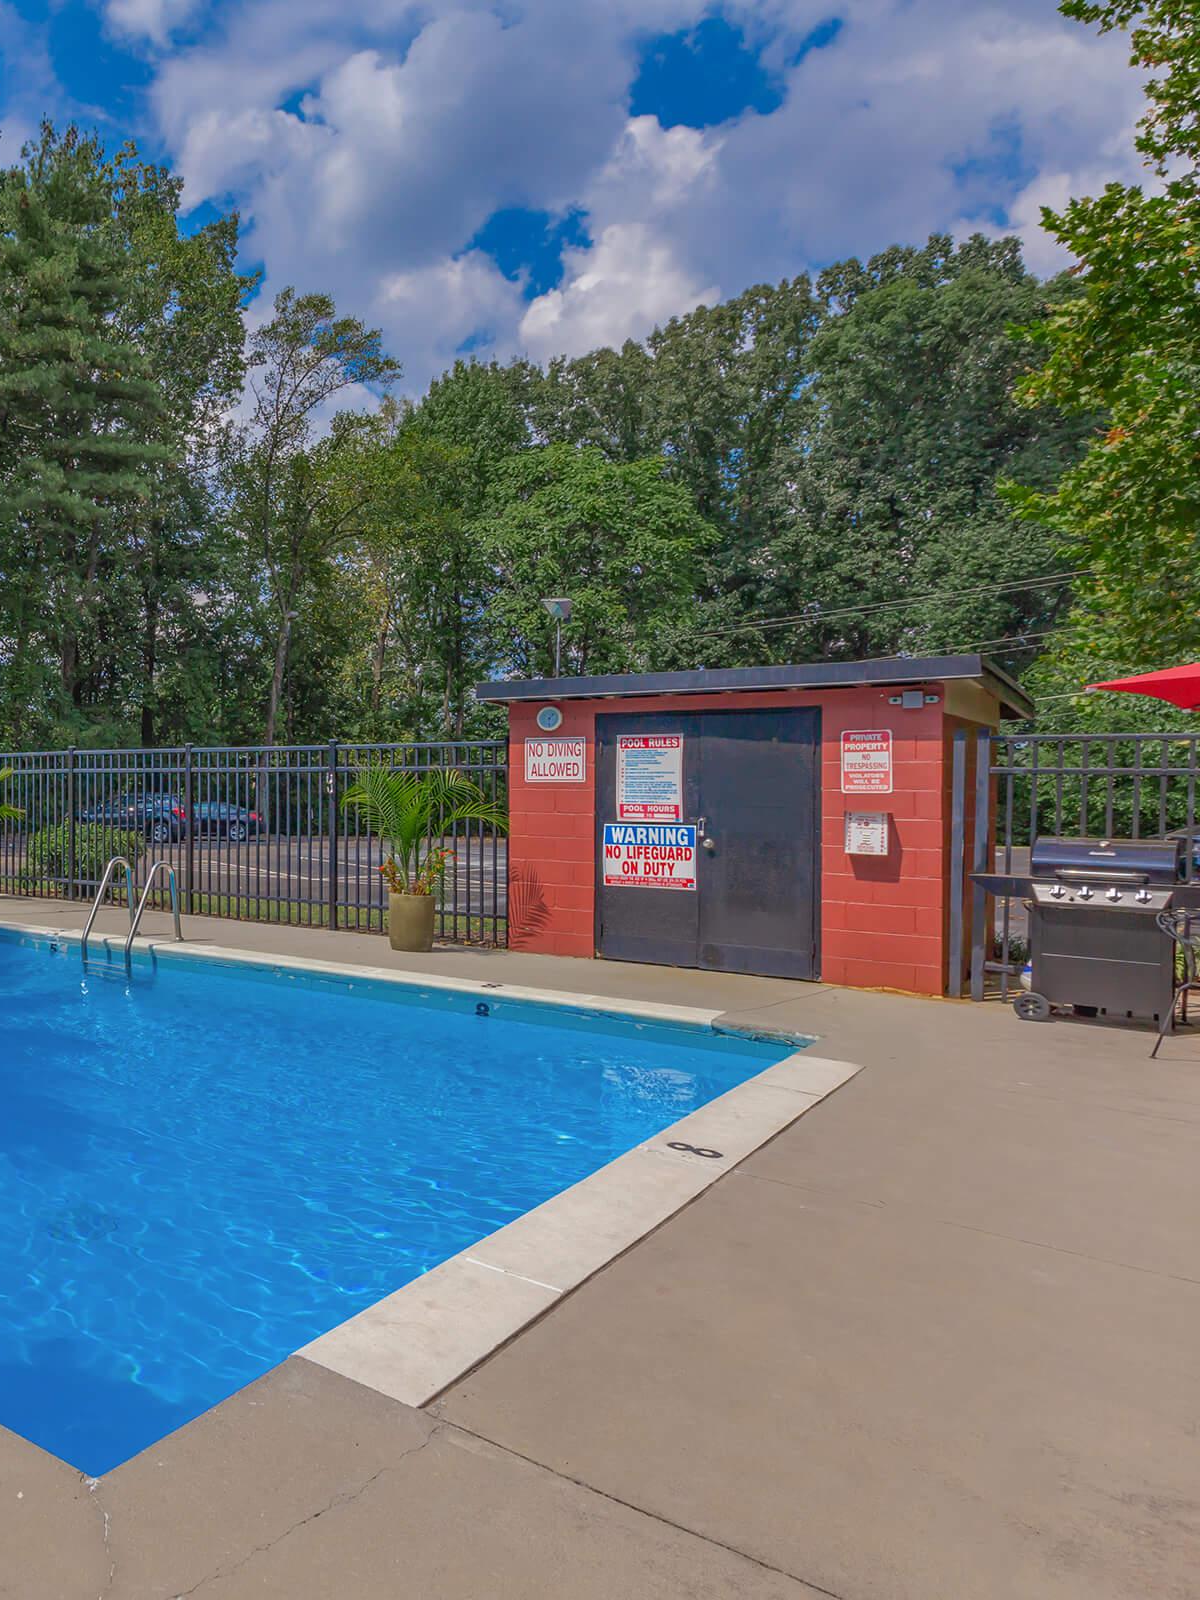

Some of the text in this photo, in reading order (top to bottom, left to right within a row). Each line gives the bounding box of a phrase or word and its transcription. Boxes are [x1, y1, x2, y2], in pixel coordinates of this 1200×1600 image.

[529, 742, 581, 757] NO DIVING
[622, 737, 678, 747] POOL RULES
[531, 762, 579, 777] ALLOWED
[647, 805, 675, 813] HOURS
[611, 827, 689, 846] WARNING
[605, 845, 692, 861] NO LIFEGUARD
[622, 861, 675, 876] ON DUTY
[666, 1141, 724, 1159] 8
